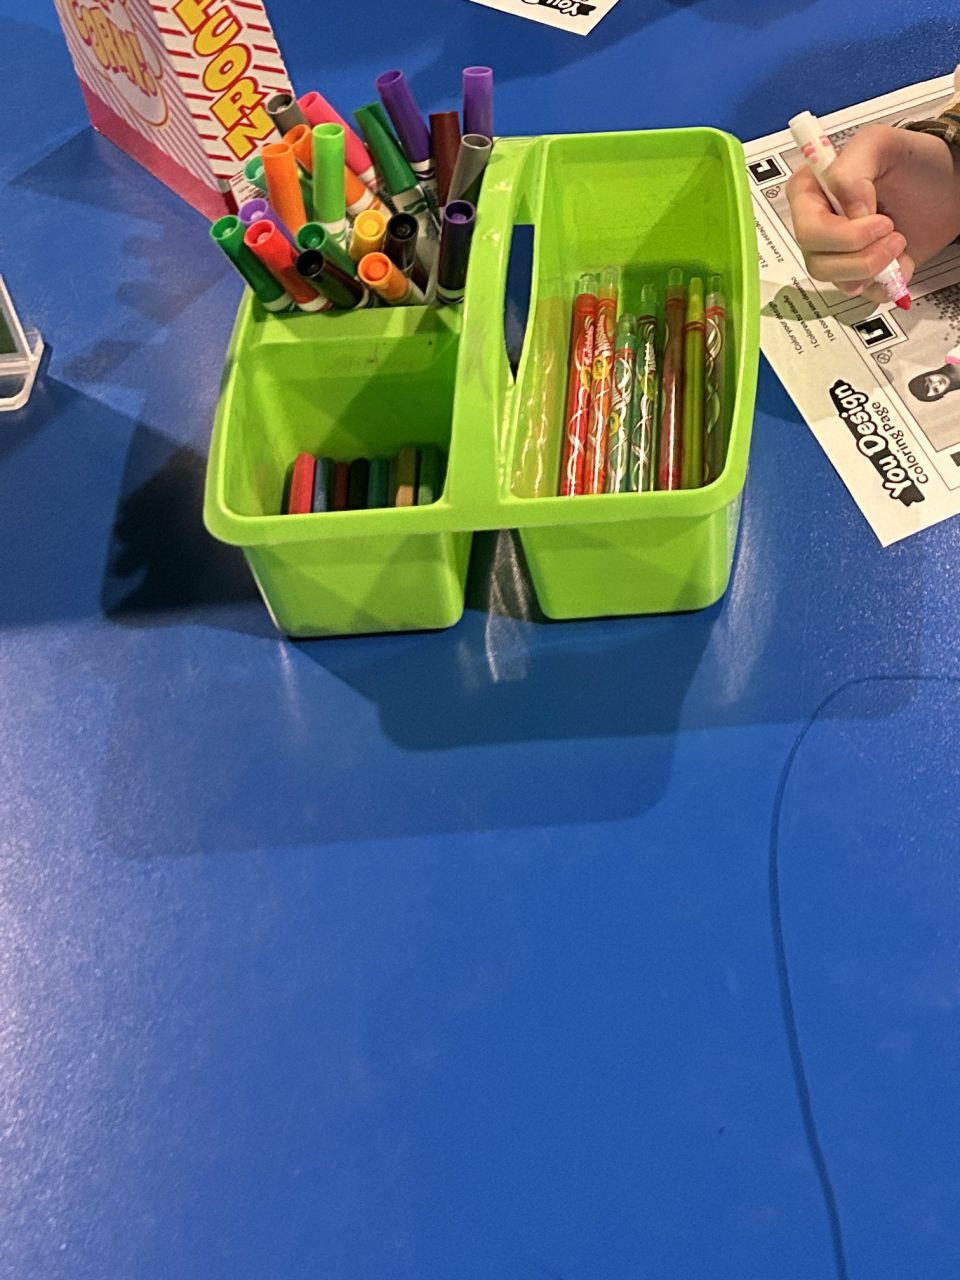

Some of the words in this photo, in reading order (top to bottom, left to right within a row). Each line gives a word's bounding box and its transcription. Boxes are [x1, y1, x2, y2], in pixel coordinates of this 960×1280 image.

[768, 300, 784, 321] design
[779, 318, 793, 334] your
[787, 334, 802, 351] Color
[832, 382, 887, 458] Design
[870, 399, 895, 432] Page
[888, 431, 928, 484] Coloring
[877, 452, 912, 499] You
